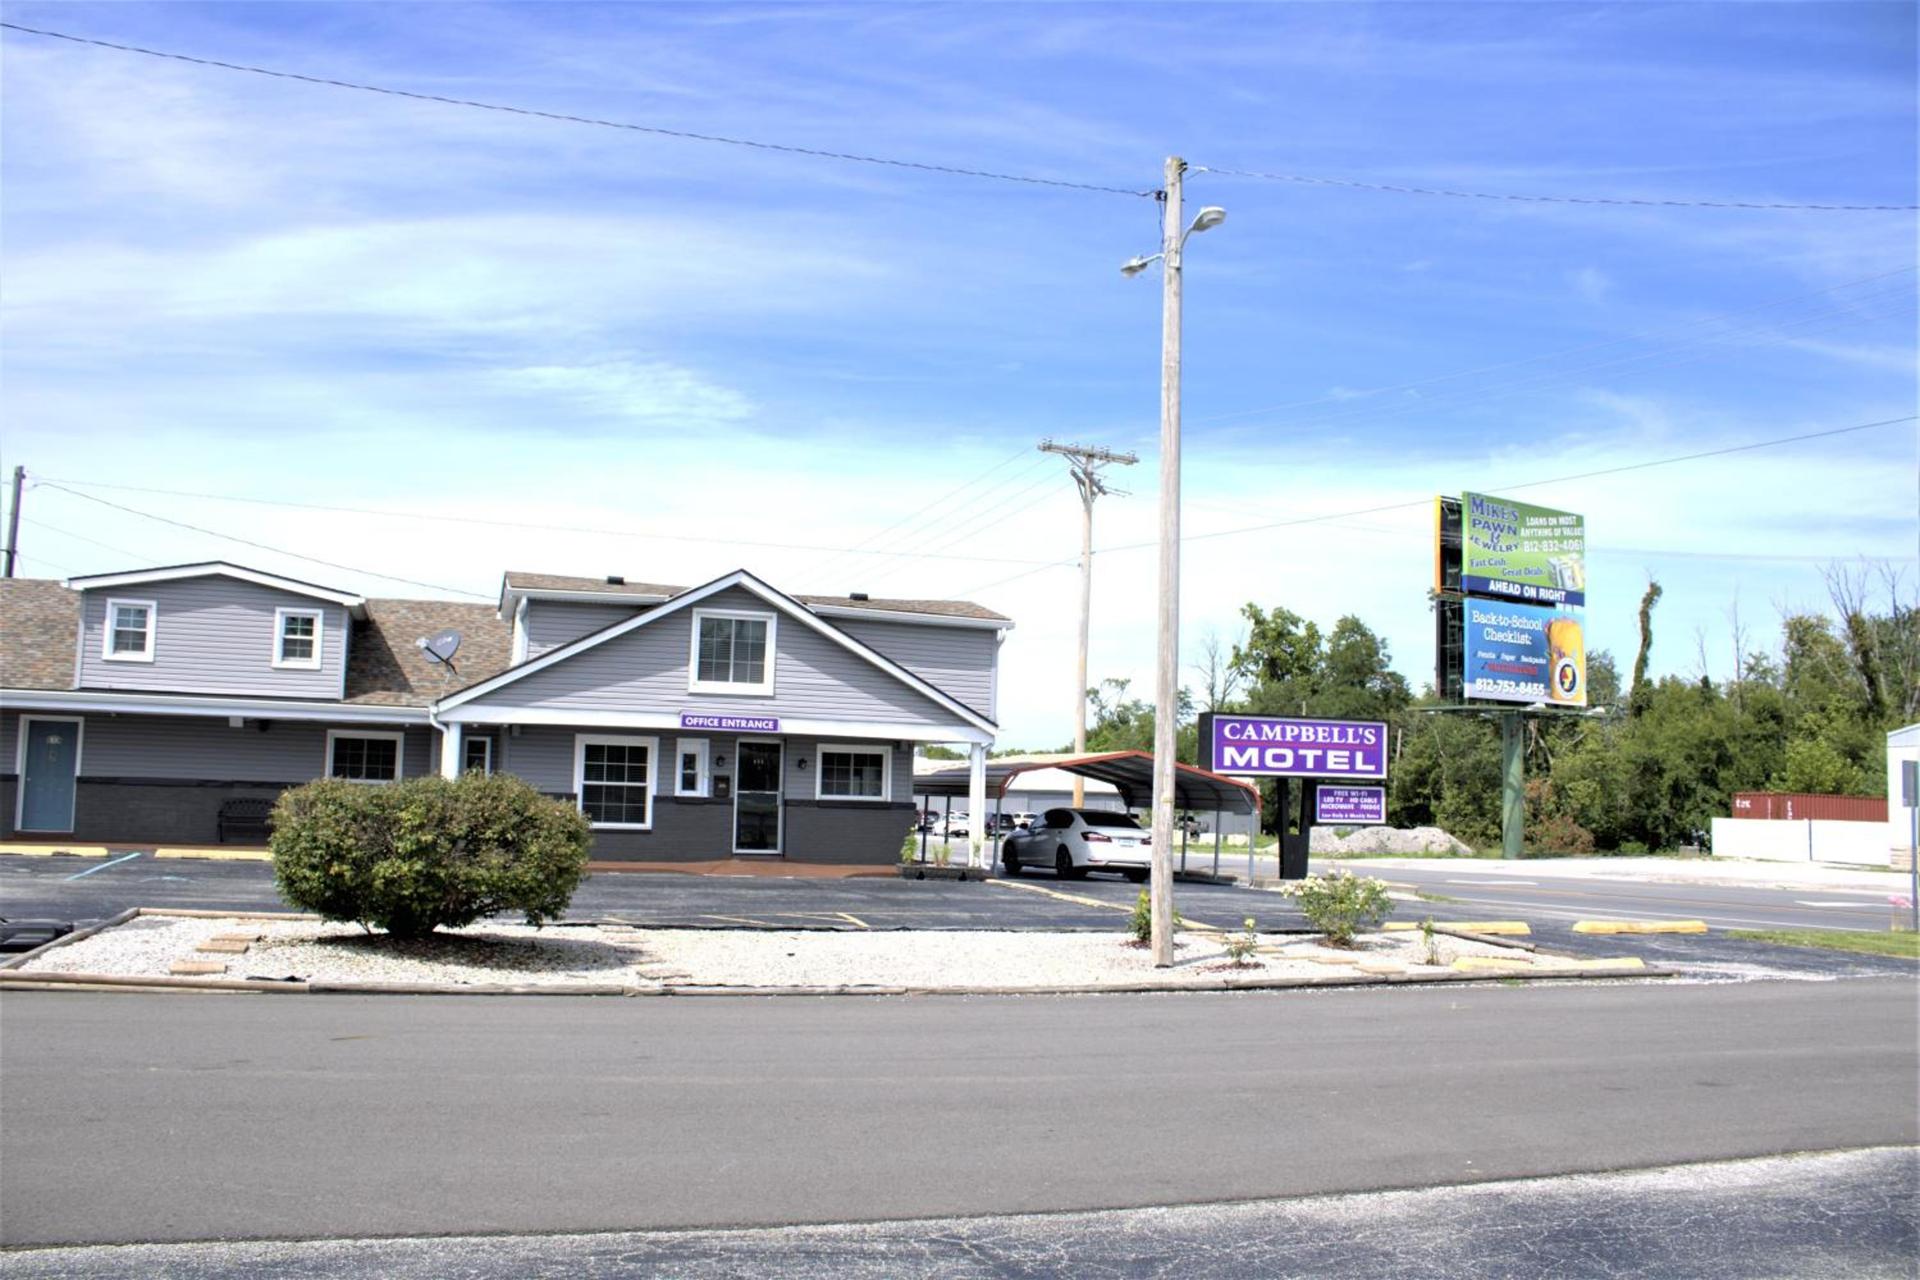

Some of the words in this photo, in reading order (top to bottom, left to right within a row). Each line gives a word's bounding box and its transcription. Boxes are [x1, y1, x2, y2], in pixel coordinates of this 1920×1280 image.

[1471, 518, 1518, 535] PAWN
[1548, 516, 1558, 526] ON
[1470, 535, 1519, 553] JEWELRY
[1488, 557, 1506, 567] Cash
[1488, 579, 1521, 596] AHEAD
[1523, 585, 1537, 598] ON
[1539, 588, 1567, 602] RIGHT
[1472, 610, 1543, 631] Back-to-School
[685, 717, 719, 727] OFFICE
[721, 718, 774, 729] ENTRANCE
[1223, 722, 1377, 745] CAMPBELL'S
[1223, 746, 1376, 771] MOTEL
